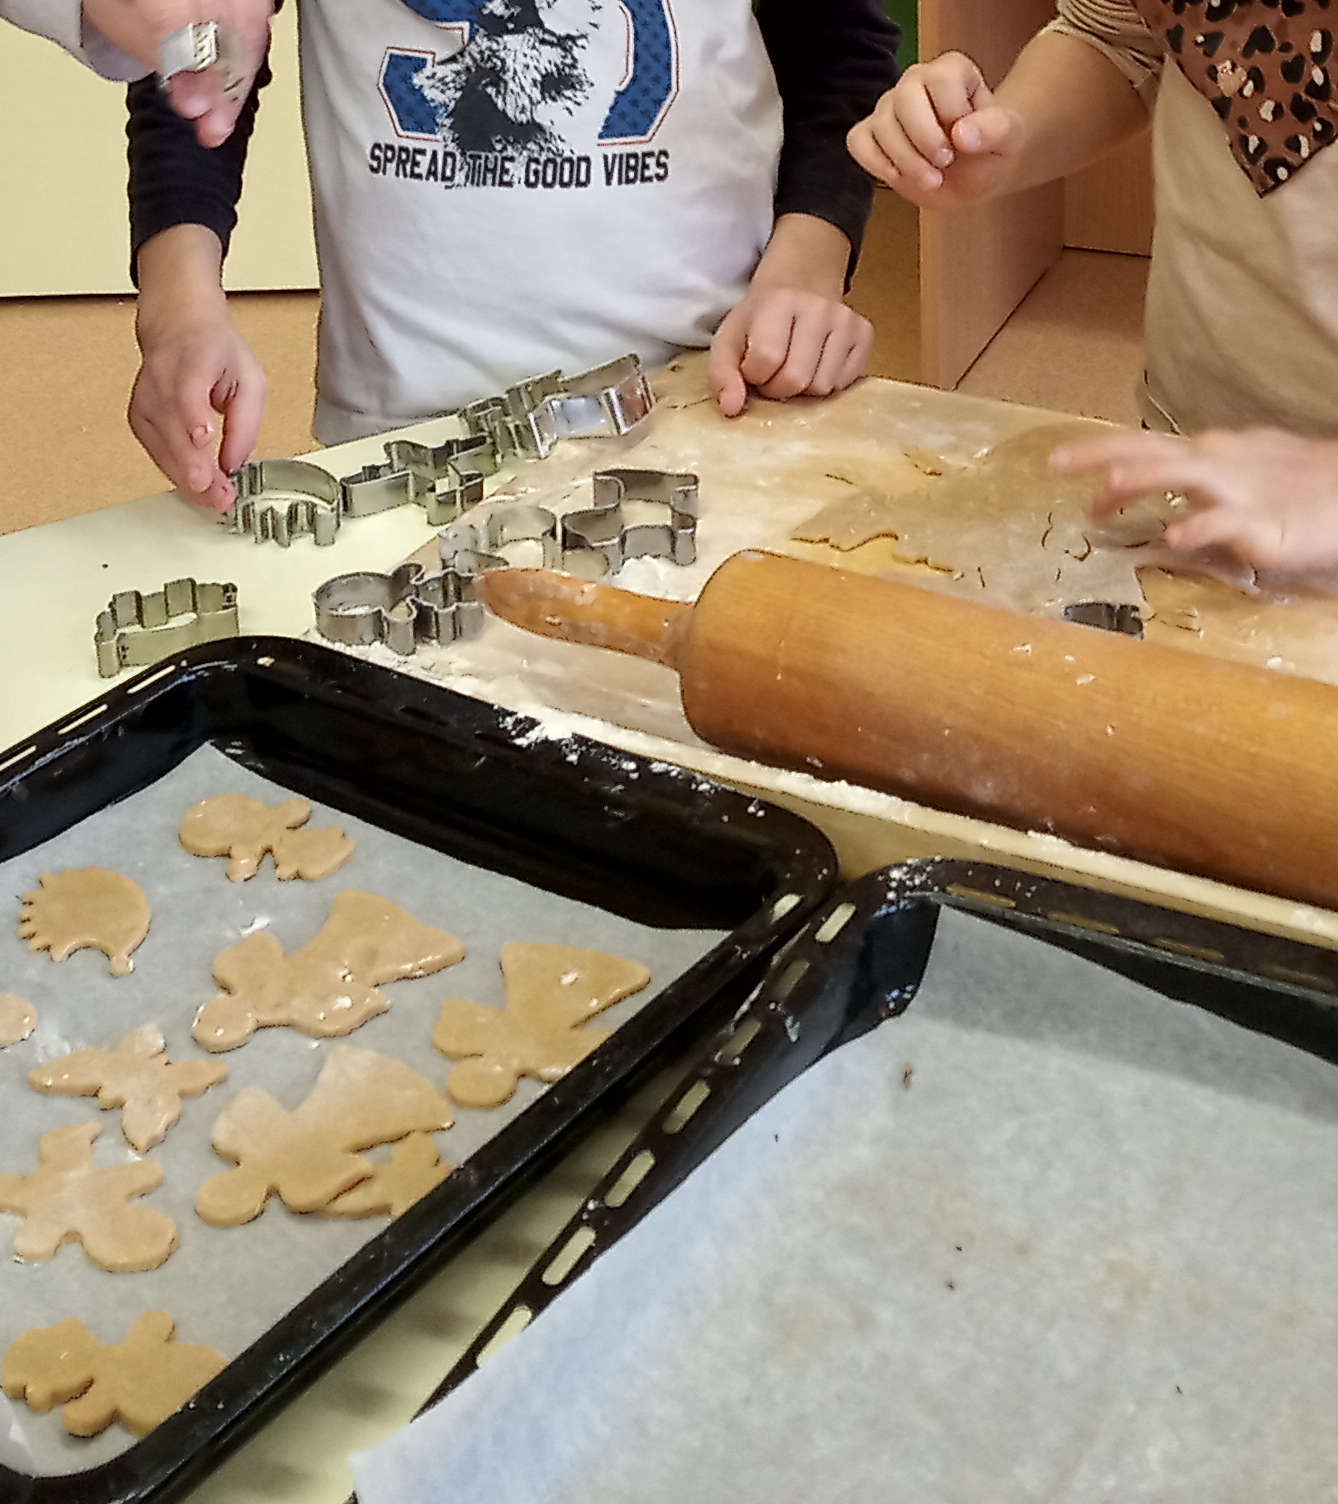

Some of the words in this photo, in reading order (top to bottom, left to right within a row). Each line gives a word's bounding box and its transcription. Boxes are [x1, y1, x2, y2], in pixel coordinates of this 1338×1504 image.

[368, 142, 456, 183] SPREAD
[467, 152, 515, 188] THE
[524, 156, 592, 190] GOOD
[603, 149, 669, 187] VIBES
